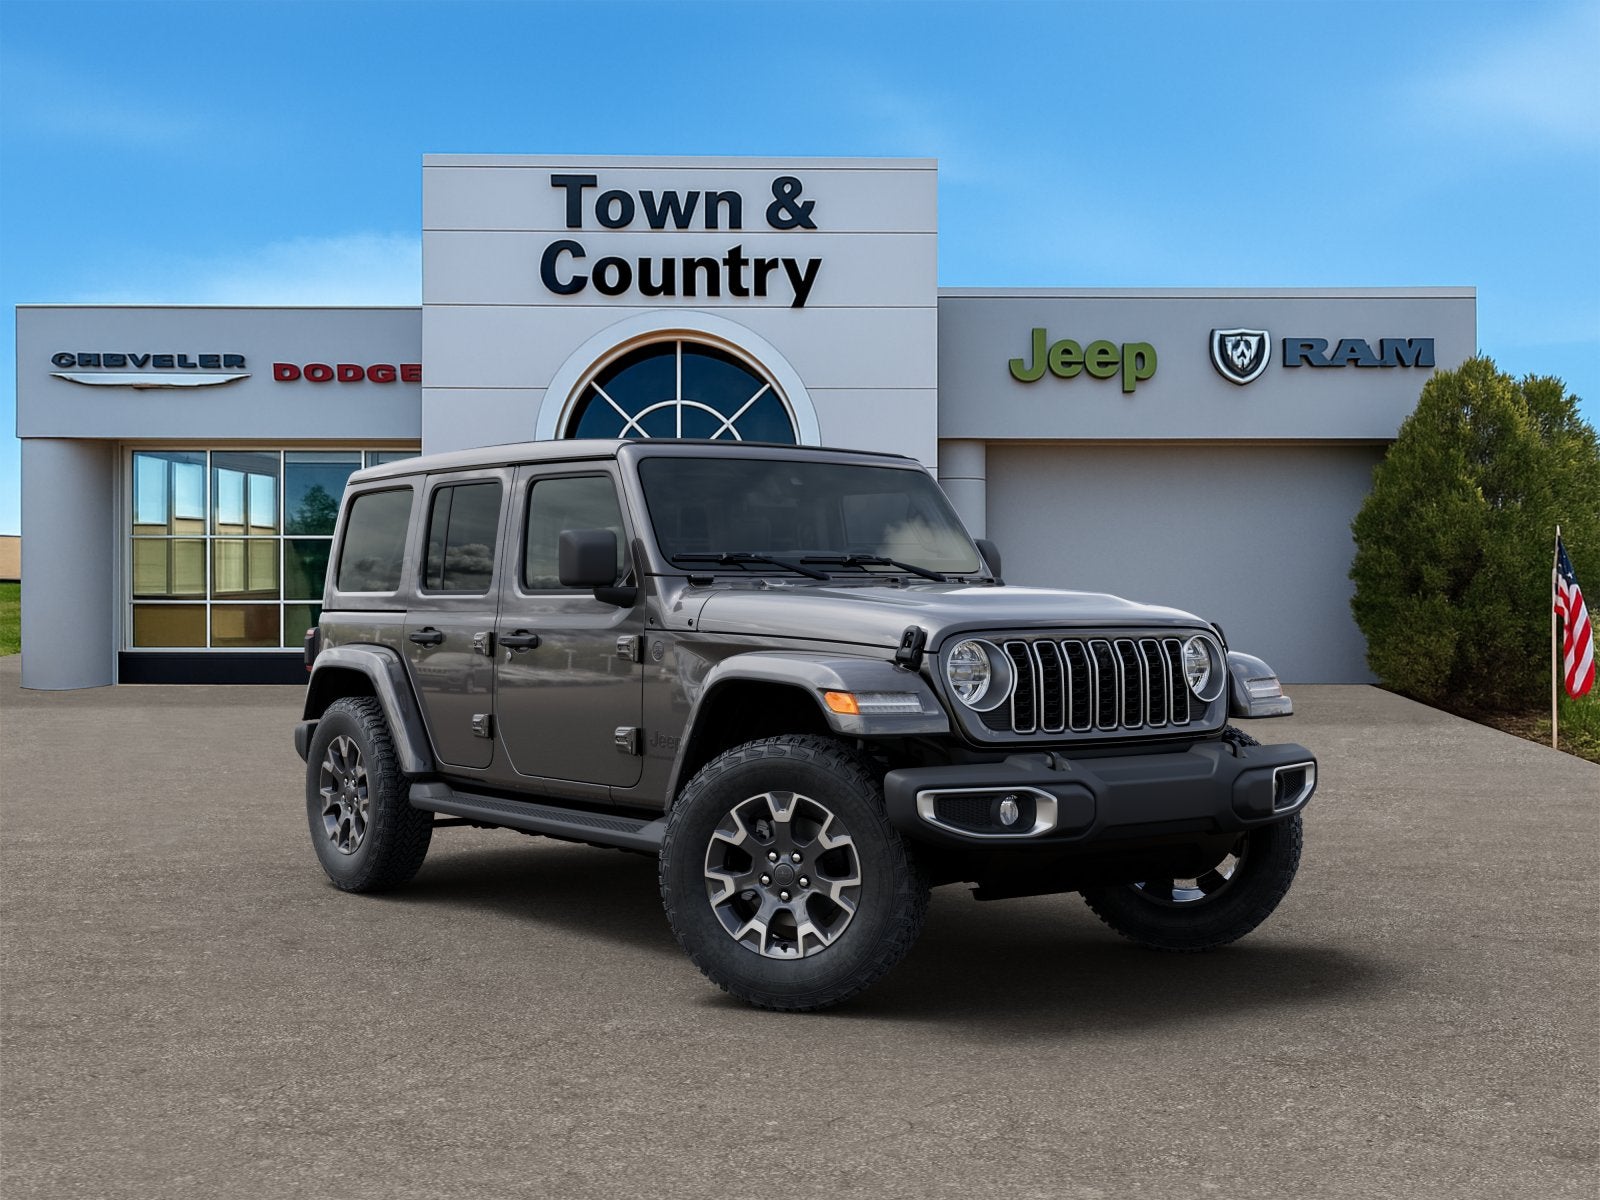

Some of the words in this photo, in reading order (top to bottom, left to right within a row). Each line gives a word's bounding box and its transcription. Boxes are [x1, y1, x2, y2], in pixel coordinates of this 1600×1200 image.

[551, 174, 742, 229] Town
[766, 176, 817, 229] &
[540, 239, 822, 308] Country
[273, 363, 422, 383] DODGE
[1009, 328, 1157, 392] Jeep
[1283, 338, 1435, 367] RAM
